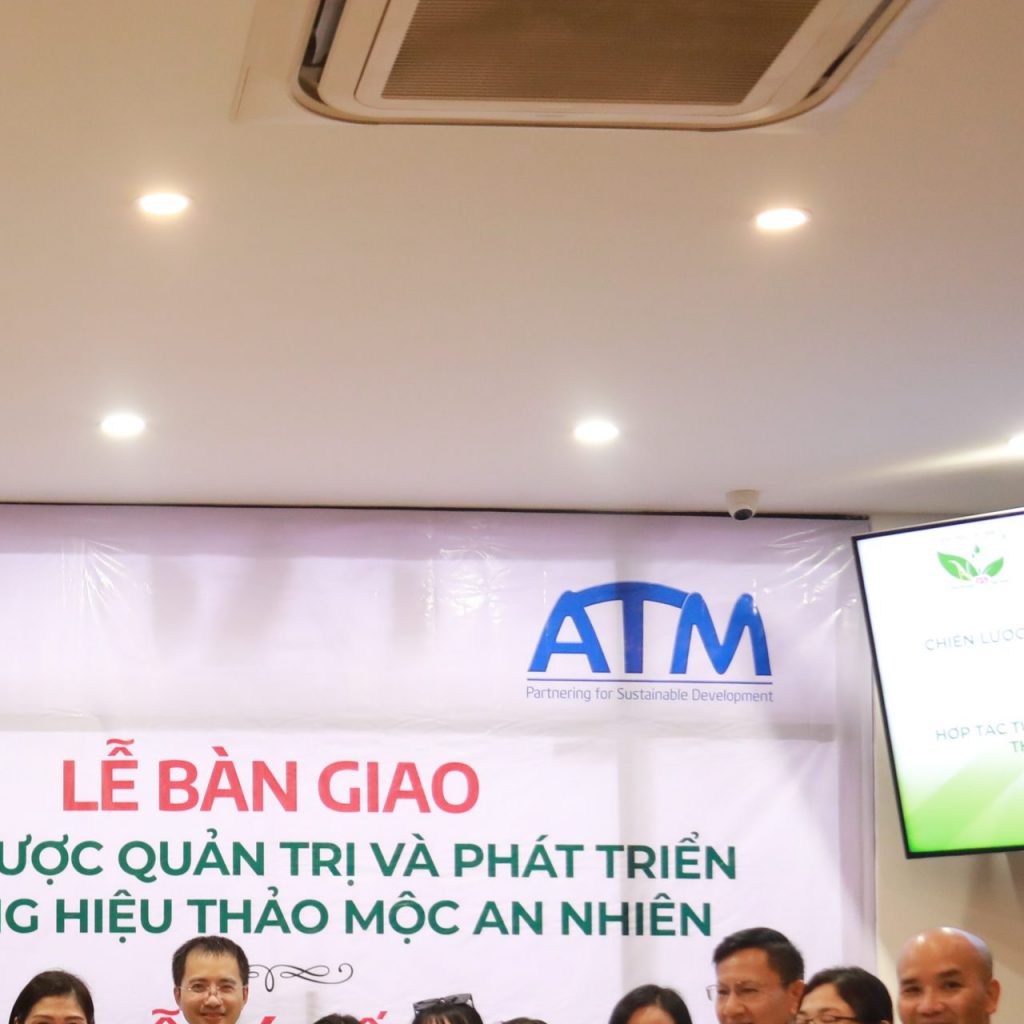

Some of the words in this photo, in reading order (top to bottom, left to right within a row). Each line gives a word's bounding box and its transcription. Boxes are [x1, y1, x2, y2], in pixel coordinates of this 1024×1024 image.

[527, 581, 772, 676] ATM
[526, 686, 592, 702] Partnering
[595, 687, 613, 700] for
[617, 687, 689, 701] Sustainable
[691, 688, 774, 704] Development
[63, 738, 139, 812] LỄ
[158, 746, 298, 812] BÀN
[318, 760, 480, 814] GIAO
[118, 828, 265, 883] QUẢN
[279, 842, 355, 886] TRỊ
[369, 833, 440, 877] VÀ
[454, 834, 584, 878] PHÁT
[595, 832, 736, 880] TRIỂN
[56, 889, 173, 943] HIỆU
[187, 886, 329, 934] THẢO
[345, 890, 460, 944] MỘC
[473, 901, 543, 935] AN
[561, 892, 711, 936] NHIÊN
